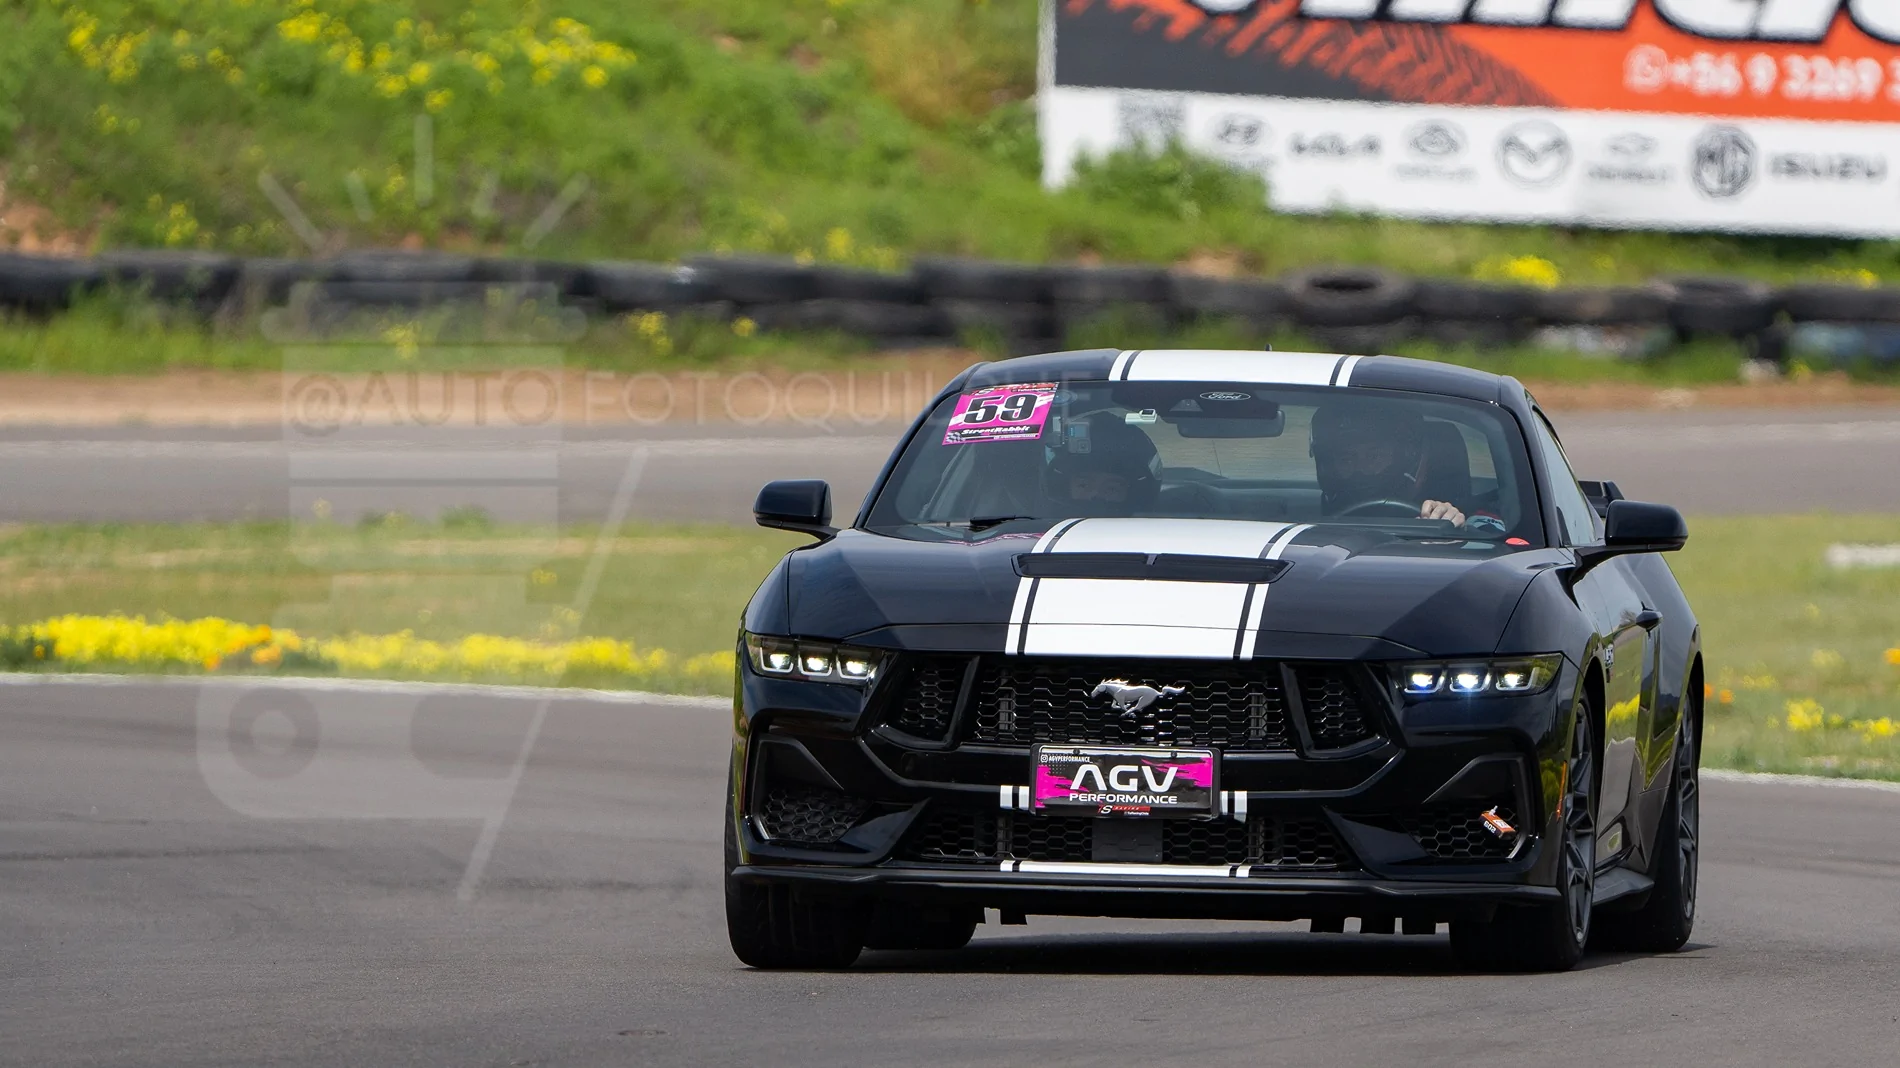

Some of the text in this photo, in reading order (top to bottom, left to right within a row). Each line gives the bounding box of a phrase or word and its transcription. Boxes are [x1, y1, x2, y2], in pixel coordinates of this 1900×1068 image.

[1746, 52, 1777, 97] 9
[963, 394, 1040, 424] 59
[1070, 764, 1178, 793] AGV
[1069, 793, 1178, 805] PERFORMANCE
